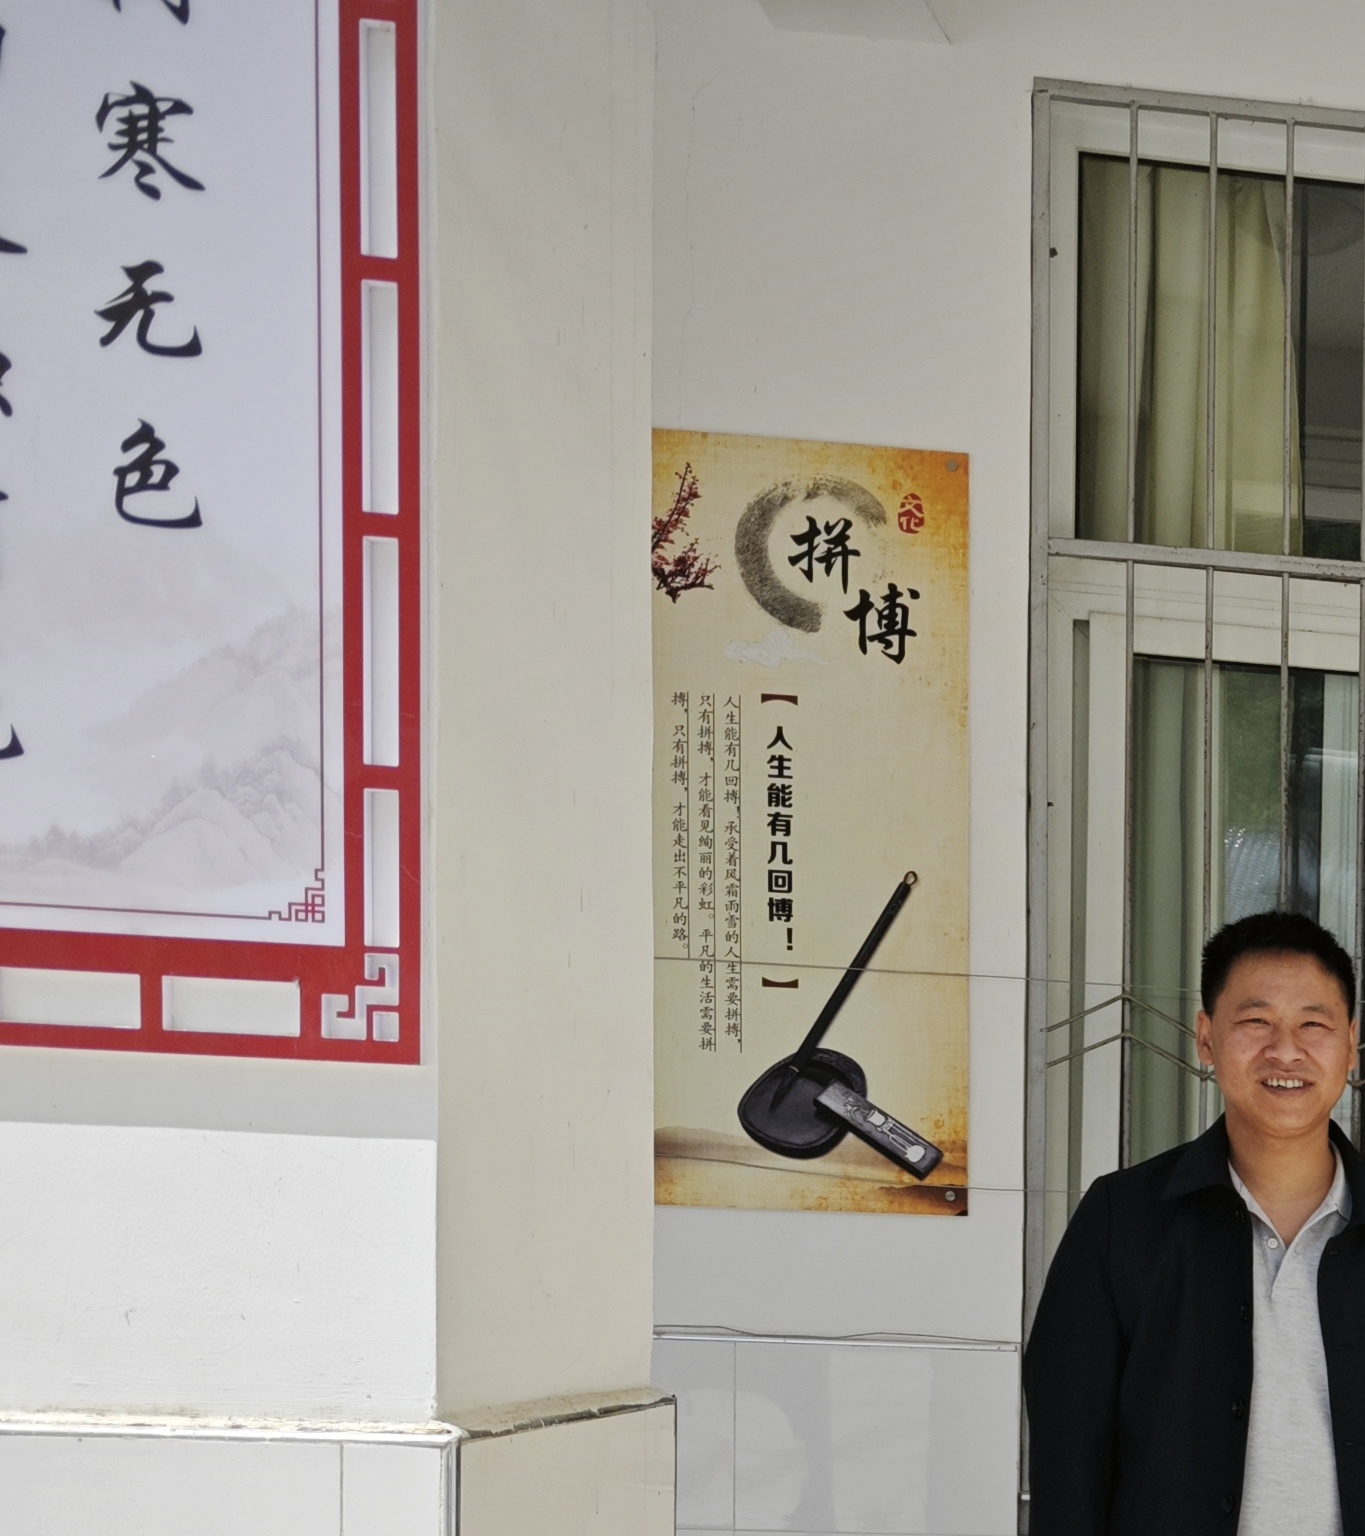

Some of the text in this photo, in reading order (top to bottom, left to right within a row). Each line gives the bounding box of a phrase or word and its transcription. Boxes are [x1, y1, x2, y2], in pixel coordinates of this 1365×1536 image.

[95, 0, 205, 529] 寒无色
[899, 495, 924, 532] 文化
